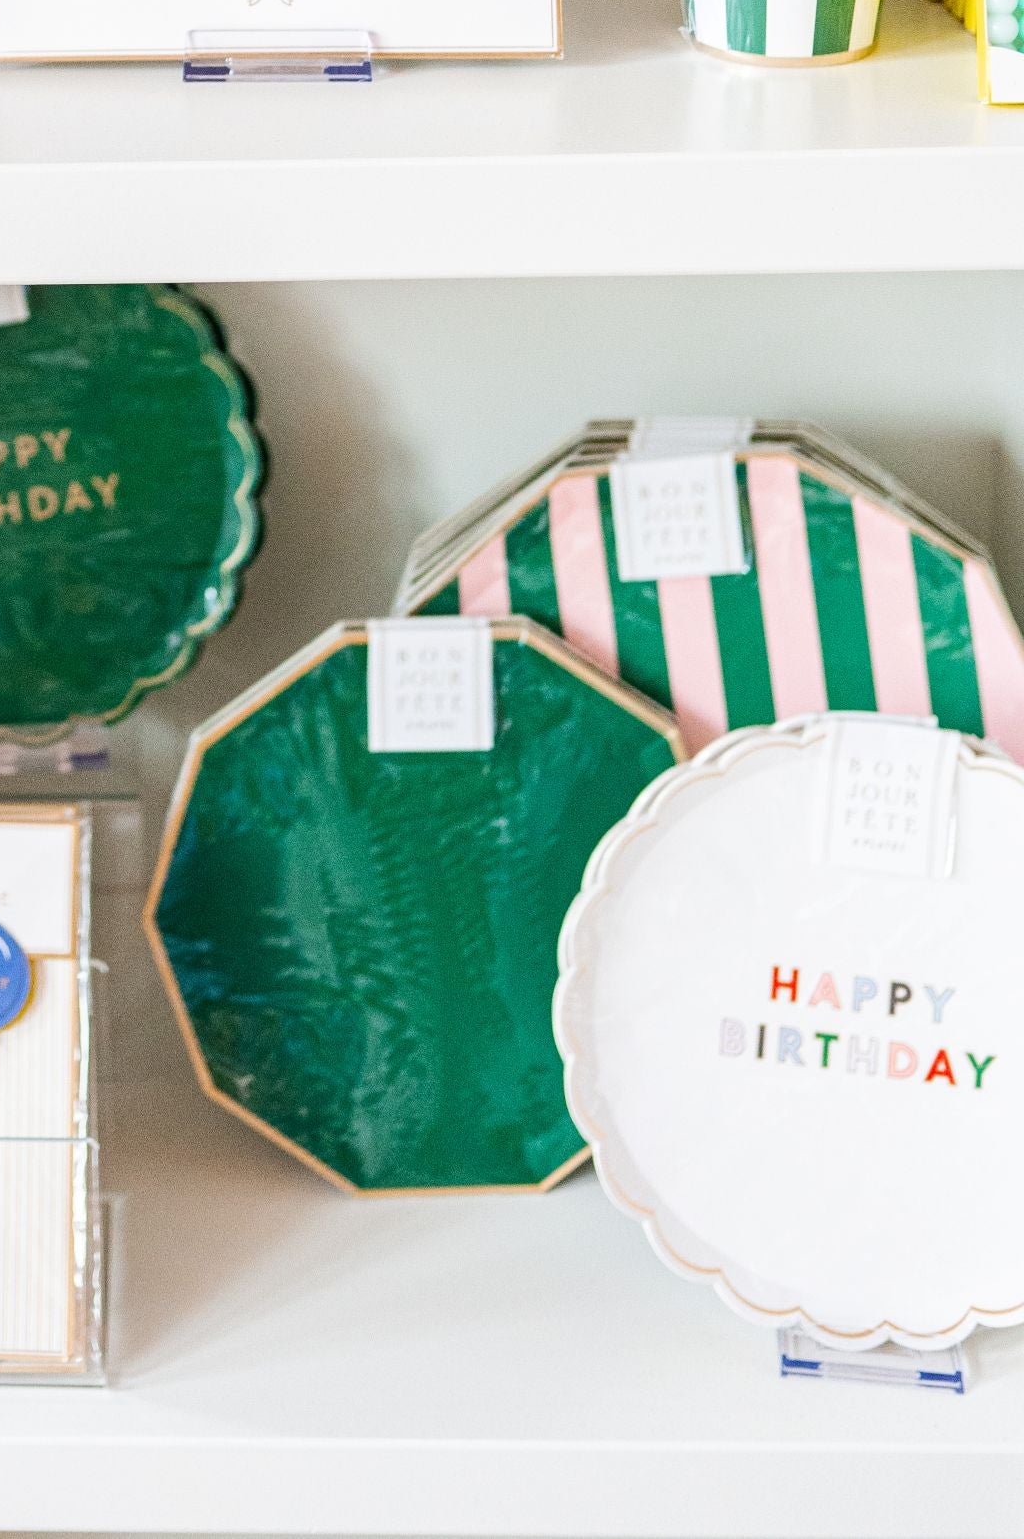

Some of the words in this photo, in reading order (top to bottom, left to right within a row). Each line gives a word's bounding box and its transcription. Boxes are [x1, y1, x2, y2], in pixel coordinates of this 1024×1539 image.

[848, 757, 923, 782] BON
[845, 782, 919, 808] JOUR
[770, 965, 955, 1024] HAPPY
[718, 1017, 996, 1089] BIRTHDAY
